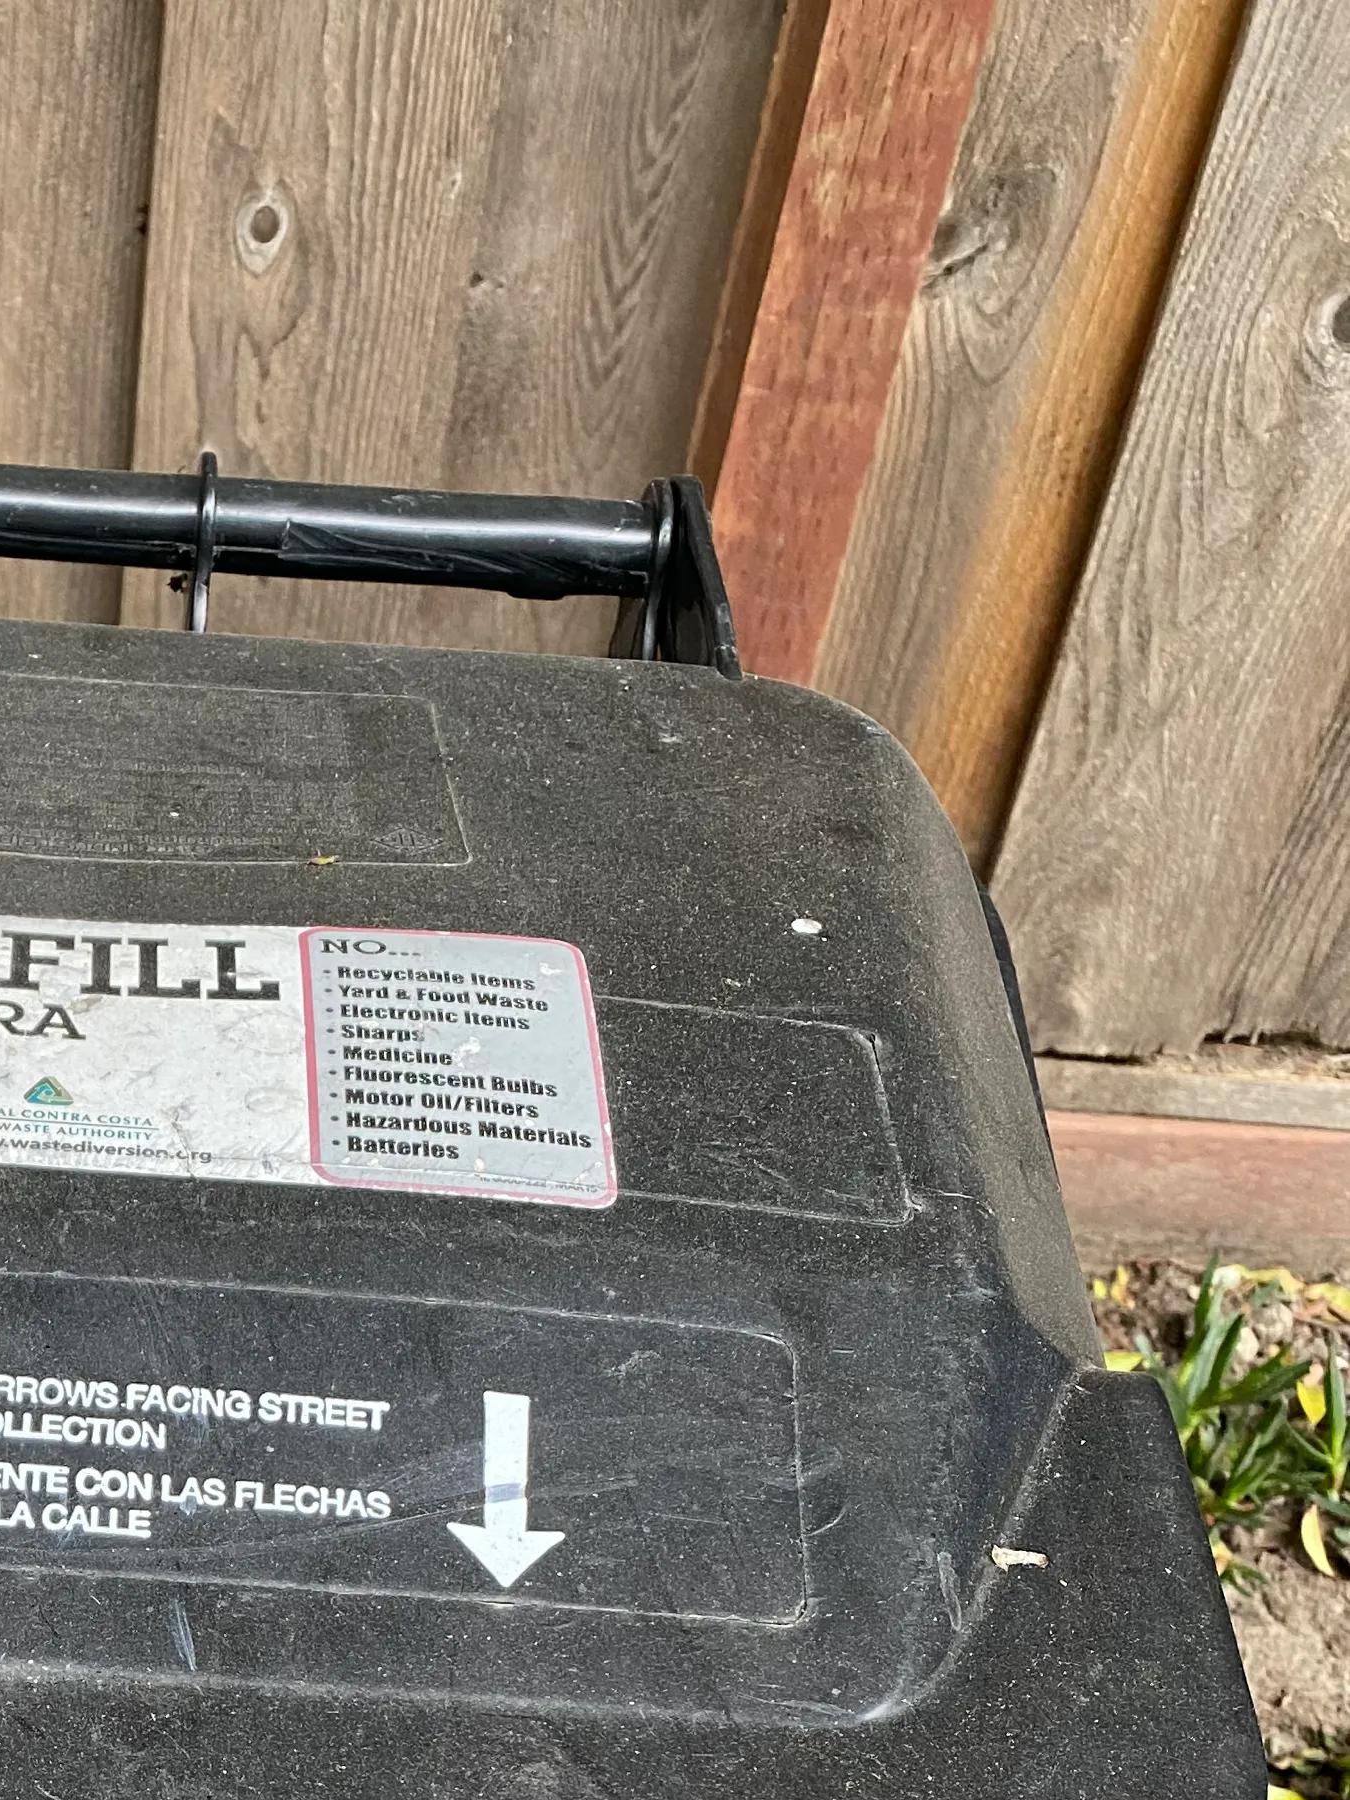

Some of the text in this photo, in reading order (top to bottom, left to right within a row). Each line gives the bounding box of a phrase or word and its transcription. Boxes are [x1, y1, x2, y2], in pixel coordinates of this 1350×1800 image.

[337, 966, 536, 991] Recyclable Items
[338, 984, 549, 1012] Yard & Food Waste
[340, 1004, 531, 1030] Electronic Items
[341, 1024, 425, 1042] Sharps
[343, 1045, 453, 1066] Medicine
[344, 1065, 558, 1097] Fluorescent Bulbs
[344, 1088, 539, 1119] Motor Oil/Filters
[21, 1109, 92, 1123] CONTRA
[97, 1114, 154, 1127] COSTA
[346, 1112, 592, 1149] Hazardous Materials
[56, 1126, 154, 1141] AUTHORITY
[347, 1134, 460, 1160] Batteries
[125, 1383, 252, 1421] FACING
[257, 1392, 392, 1432] STREET
[75, 1466, 154, 1501] CON
[160, 1473, 227, 1508] LAS
[234, 1480, 393, 1519] FLECHAS
[41, 1503, 152, 1539] CALLE
